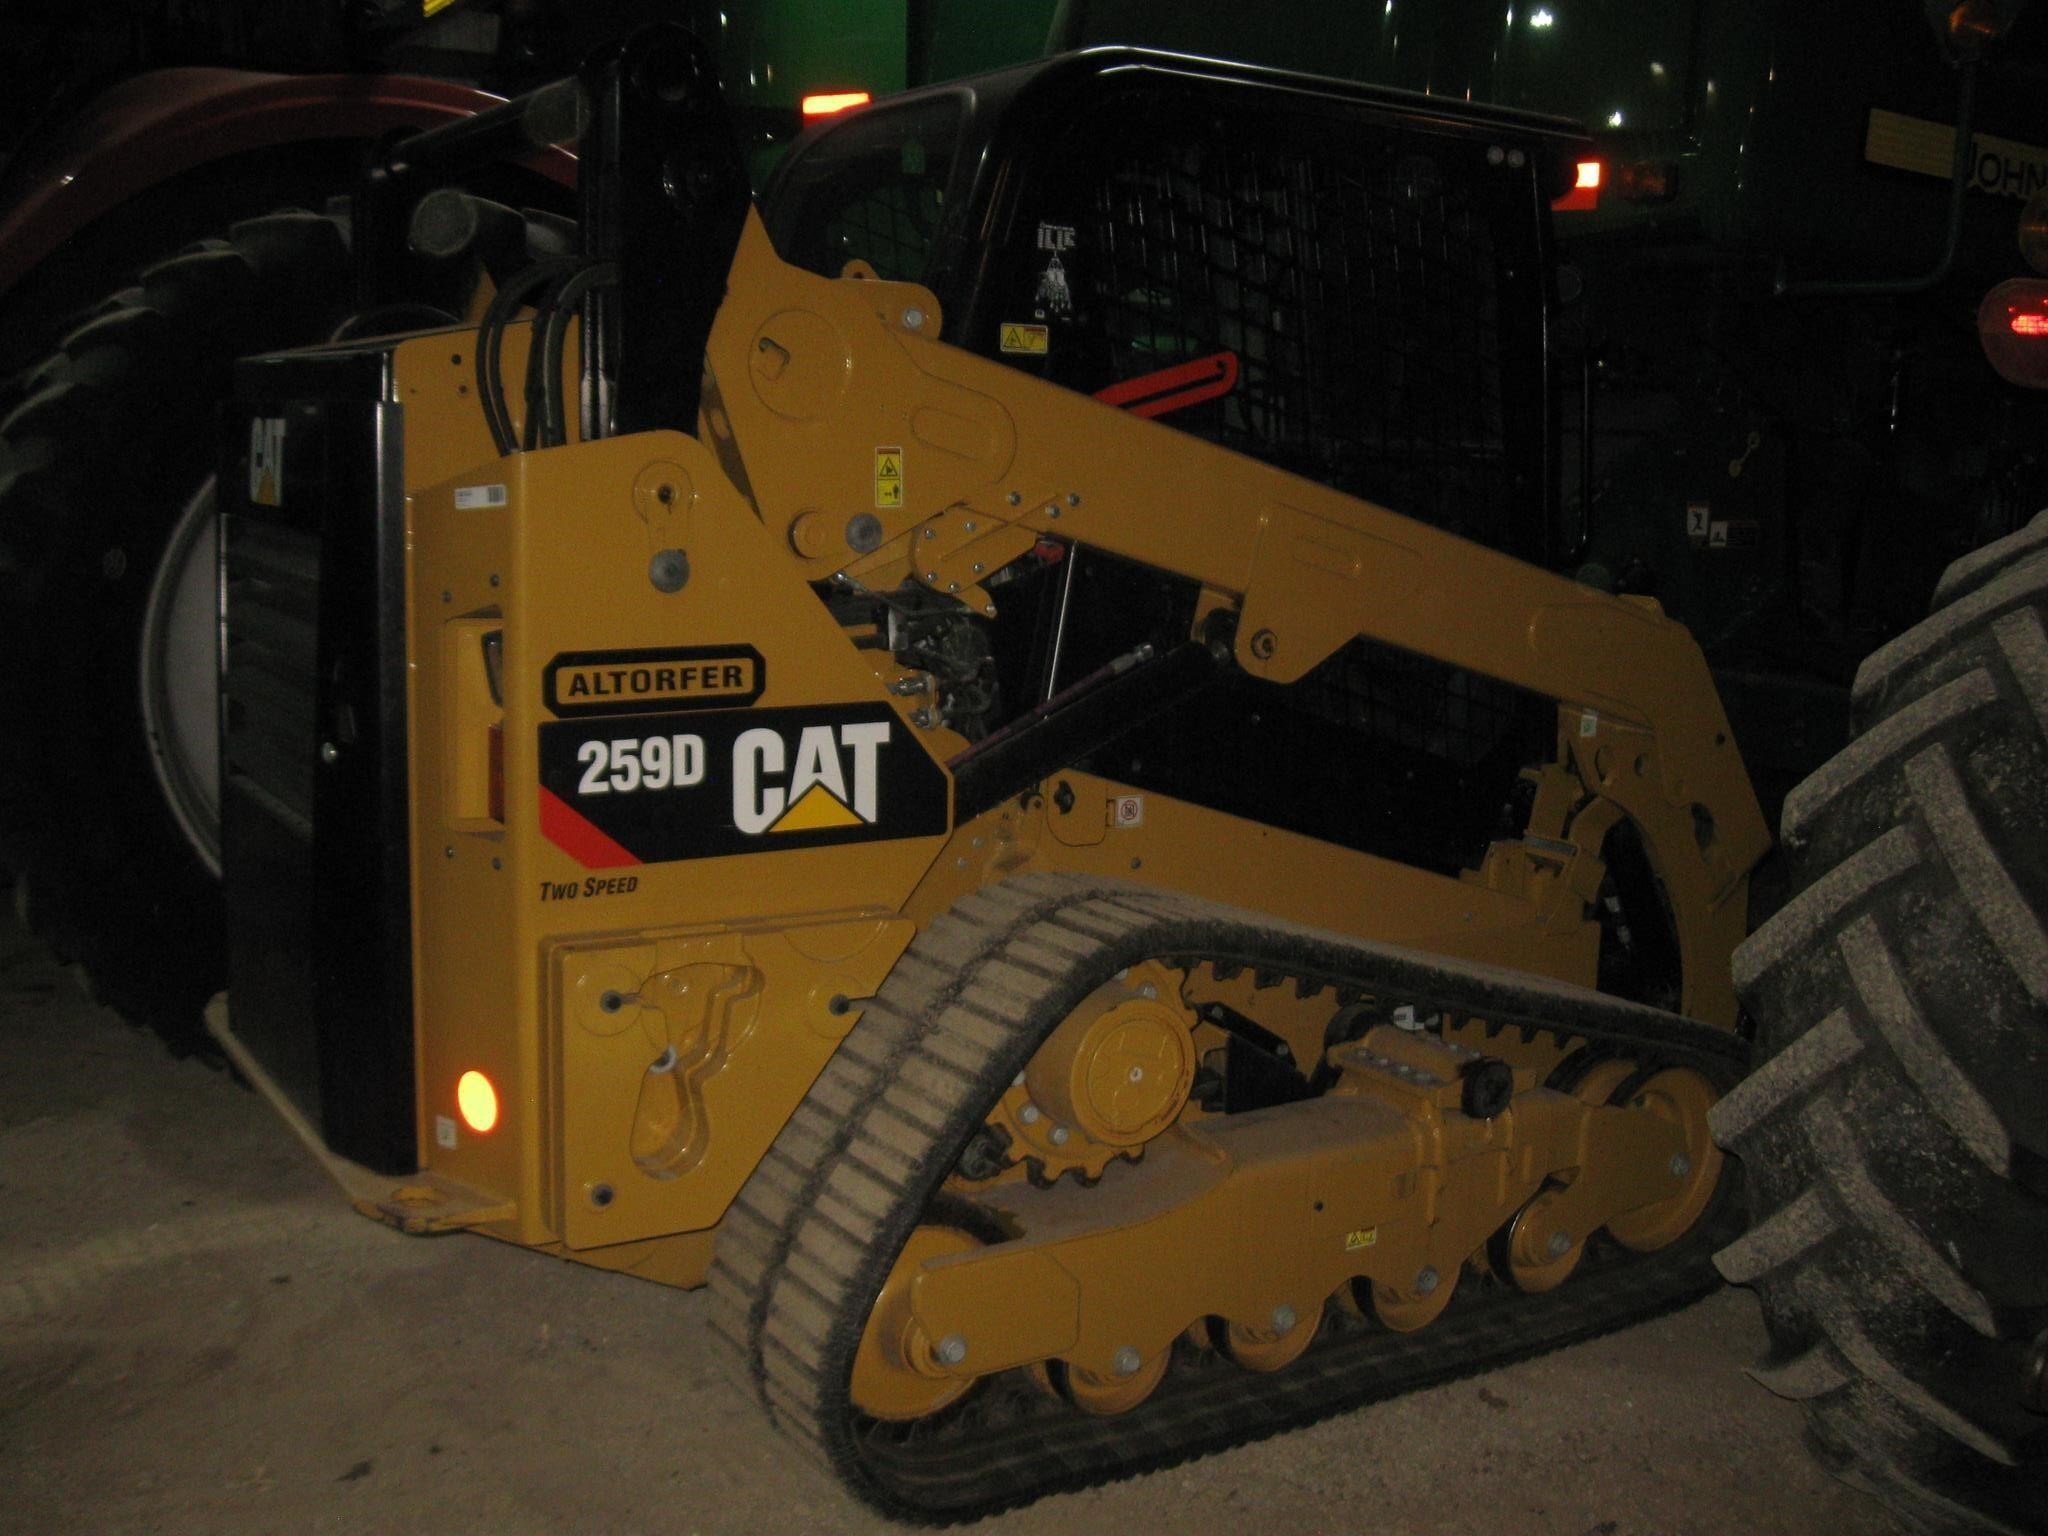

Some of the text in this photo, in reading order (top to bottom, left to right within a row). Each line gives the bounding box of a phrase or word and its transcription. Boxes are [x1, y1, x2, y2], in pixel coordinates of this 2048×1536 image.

[1967, 141, 2048, 196] JOHN
[567, 665, 743, 697] ALTORFER
[577, 721, 891, 836] 259D CAT
[540, 876, 638, 902] TWO SPEED
